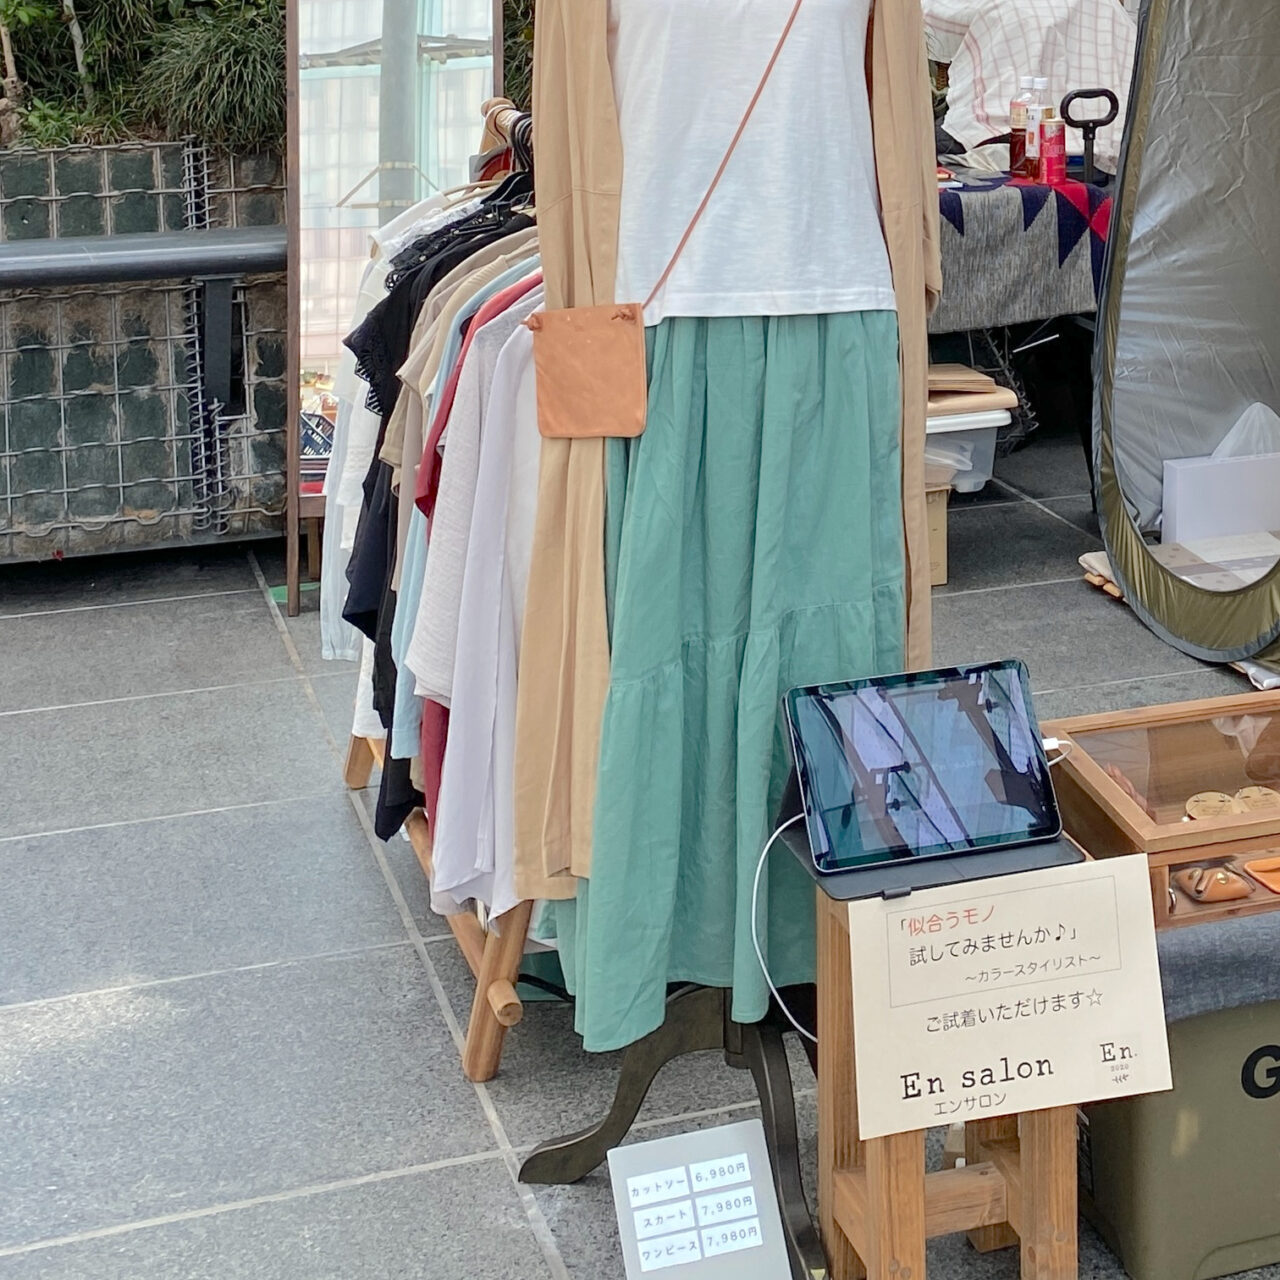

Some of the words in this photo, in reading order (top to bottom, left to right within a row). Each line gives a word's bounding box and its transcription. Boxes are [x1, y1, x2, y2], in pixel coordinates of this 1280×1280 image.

[900, 905, 995, 937] 「似合うモノ
[900, 1073, 945, 1100] En
[962, 1057, 1054, 1089] salon
[934, 1092, 1007, 1116] エンサロン
[631, 1178, 685, 1197] カットソー
[695, 1162, 746, 1183] 6,980円
[644, 1209, 687, 1228] スカート
[701, 1195, 753, 1216] 7,980円
[642, 1241, 697, 1261] ワンピース
[706, 1226, 757, 1247] 7,980円
